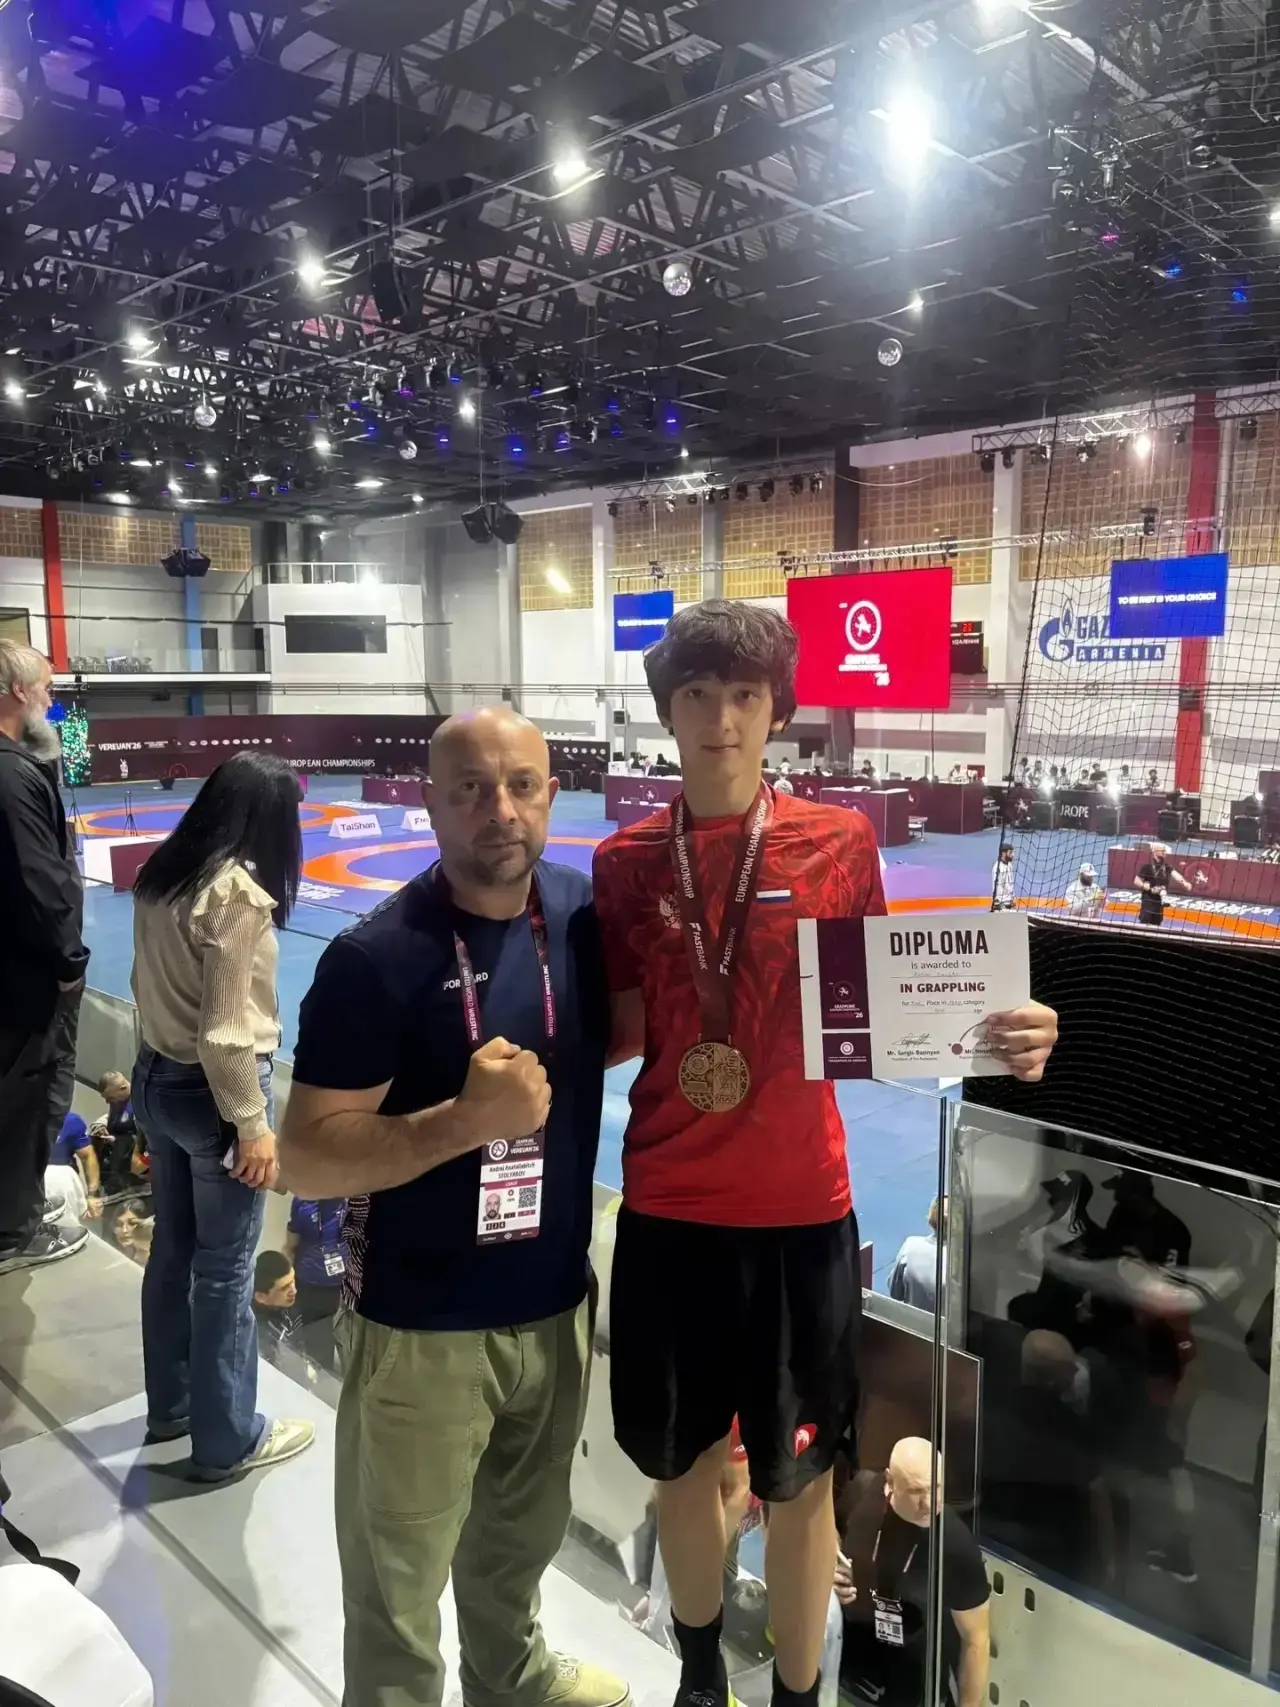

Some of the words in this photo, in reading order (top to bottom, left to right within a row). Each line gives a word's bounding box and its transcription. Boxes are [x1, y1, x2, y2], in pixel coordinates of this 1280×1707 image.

[1076, 615, 1112, 639] GAZ
[1078, 647, 1163, 660] ARMENIA
[286, 759, 321, 767] UROPEAN
[322, 759, 376, 767] CHAMPIONSHIPS
[1060, 804, 1090, 818] ROPE
[340, 821, 376, 831] TaiShan
[735, 857, 755, 903] EUROPEAN
[749, 798, 769, 859] CHAMPIONSHIP
[675, 835, 695, 899] CHAMPIONSHIP
[692, 931, 708, 970] FASTBANK
[723, 927, 737, 966] FASTBANK
[890, 930, 989, 956] DIPLOMA
[911, 961, 918, 969] is
[920, 960, 959, 969] awarded
[443, 972, 489, 991] FORRD
[543, 964, 551, 995] WRESTLING
[900, 983, 913, 993] IN
[917, 982, 986, 993] GRAPPLING
[465, 987, 474, 1007] WORLD
[468, 1008, 479, 1040] WRESTLING
[489, 1164, 505, 1172] Andrei
